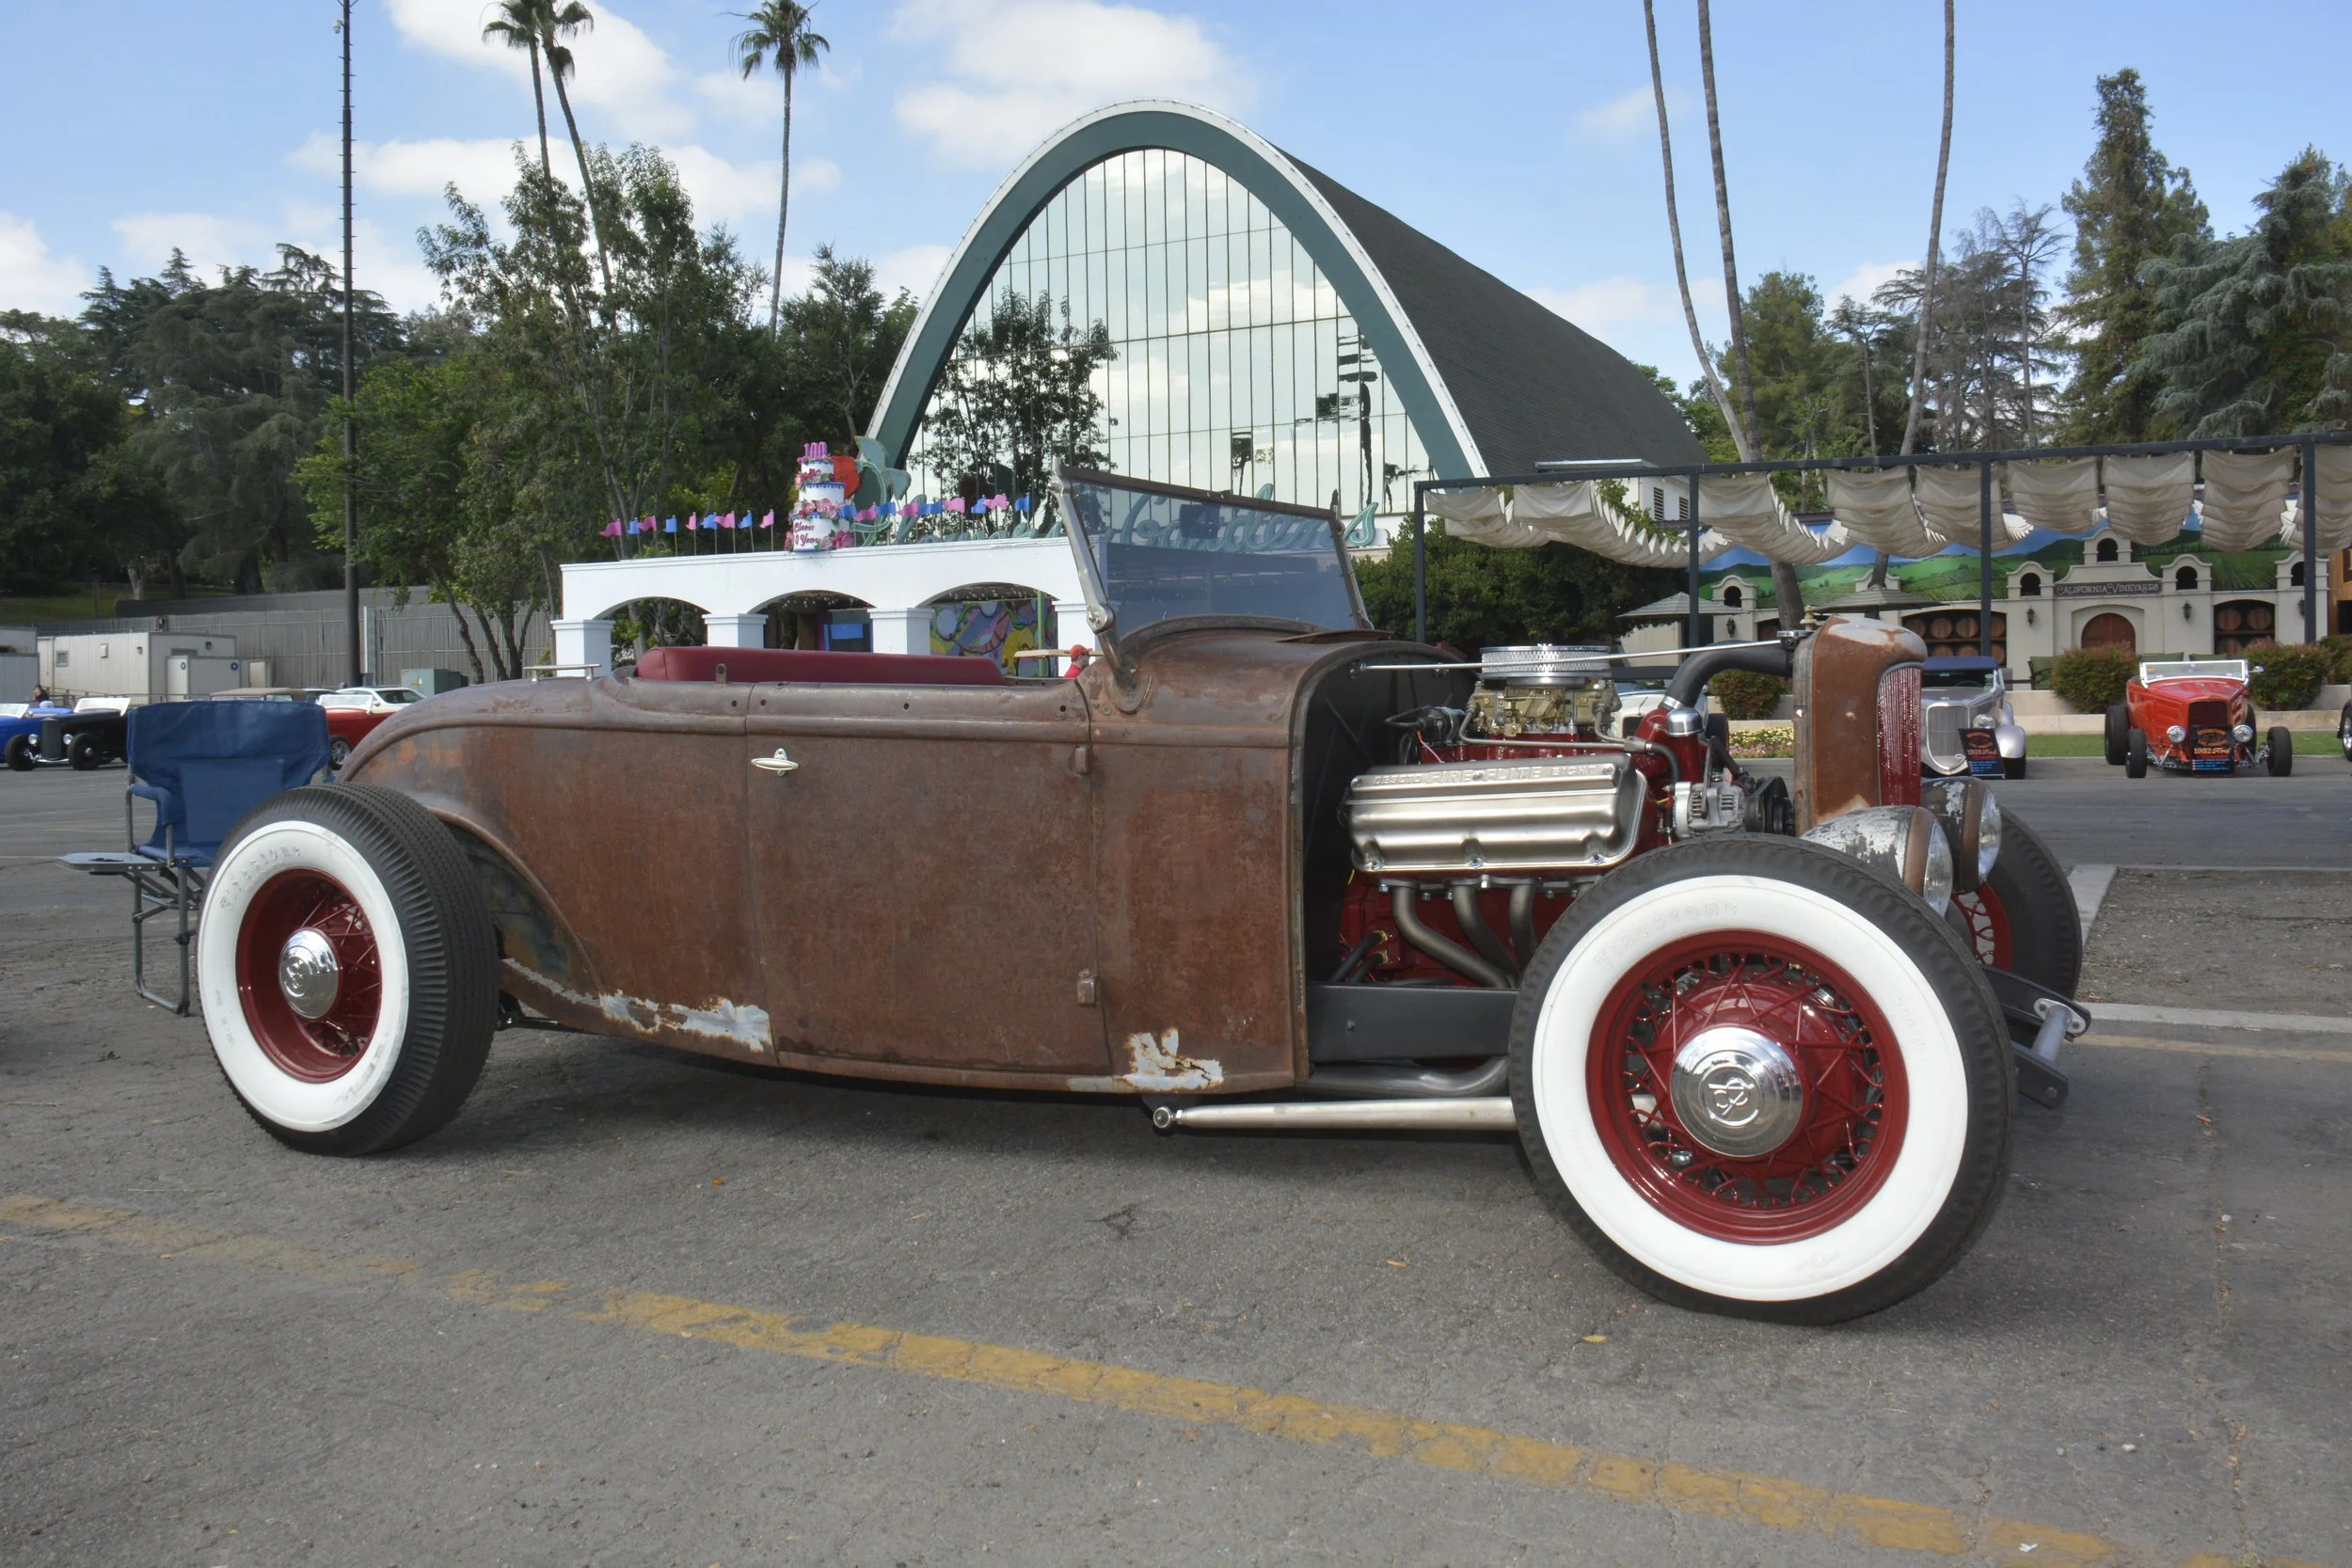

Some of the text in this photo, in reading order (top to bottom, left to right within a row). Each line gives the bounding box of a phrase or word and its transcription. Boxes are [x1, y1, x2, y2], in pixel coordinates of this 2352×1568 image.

[803, 441, 828, 460] 100
[2057, 582, 2159, 595] CALIFORNIA VINEYARDS
[1374, 774, 1422, 785] DESOTO
[1549, 764, 1598, 778] EIGHT
